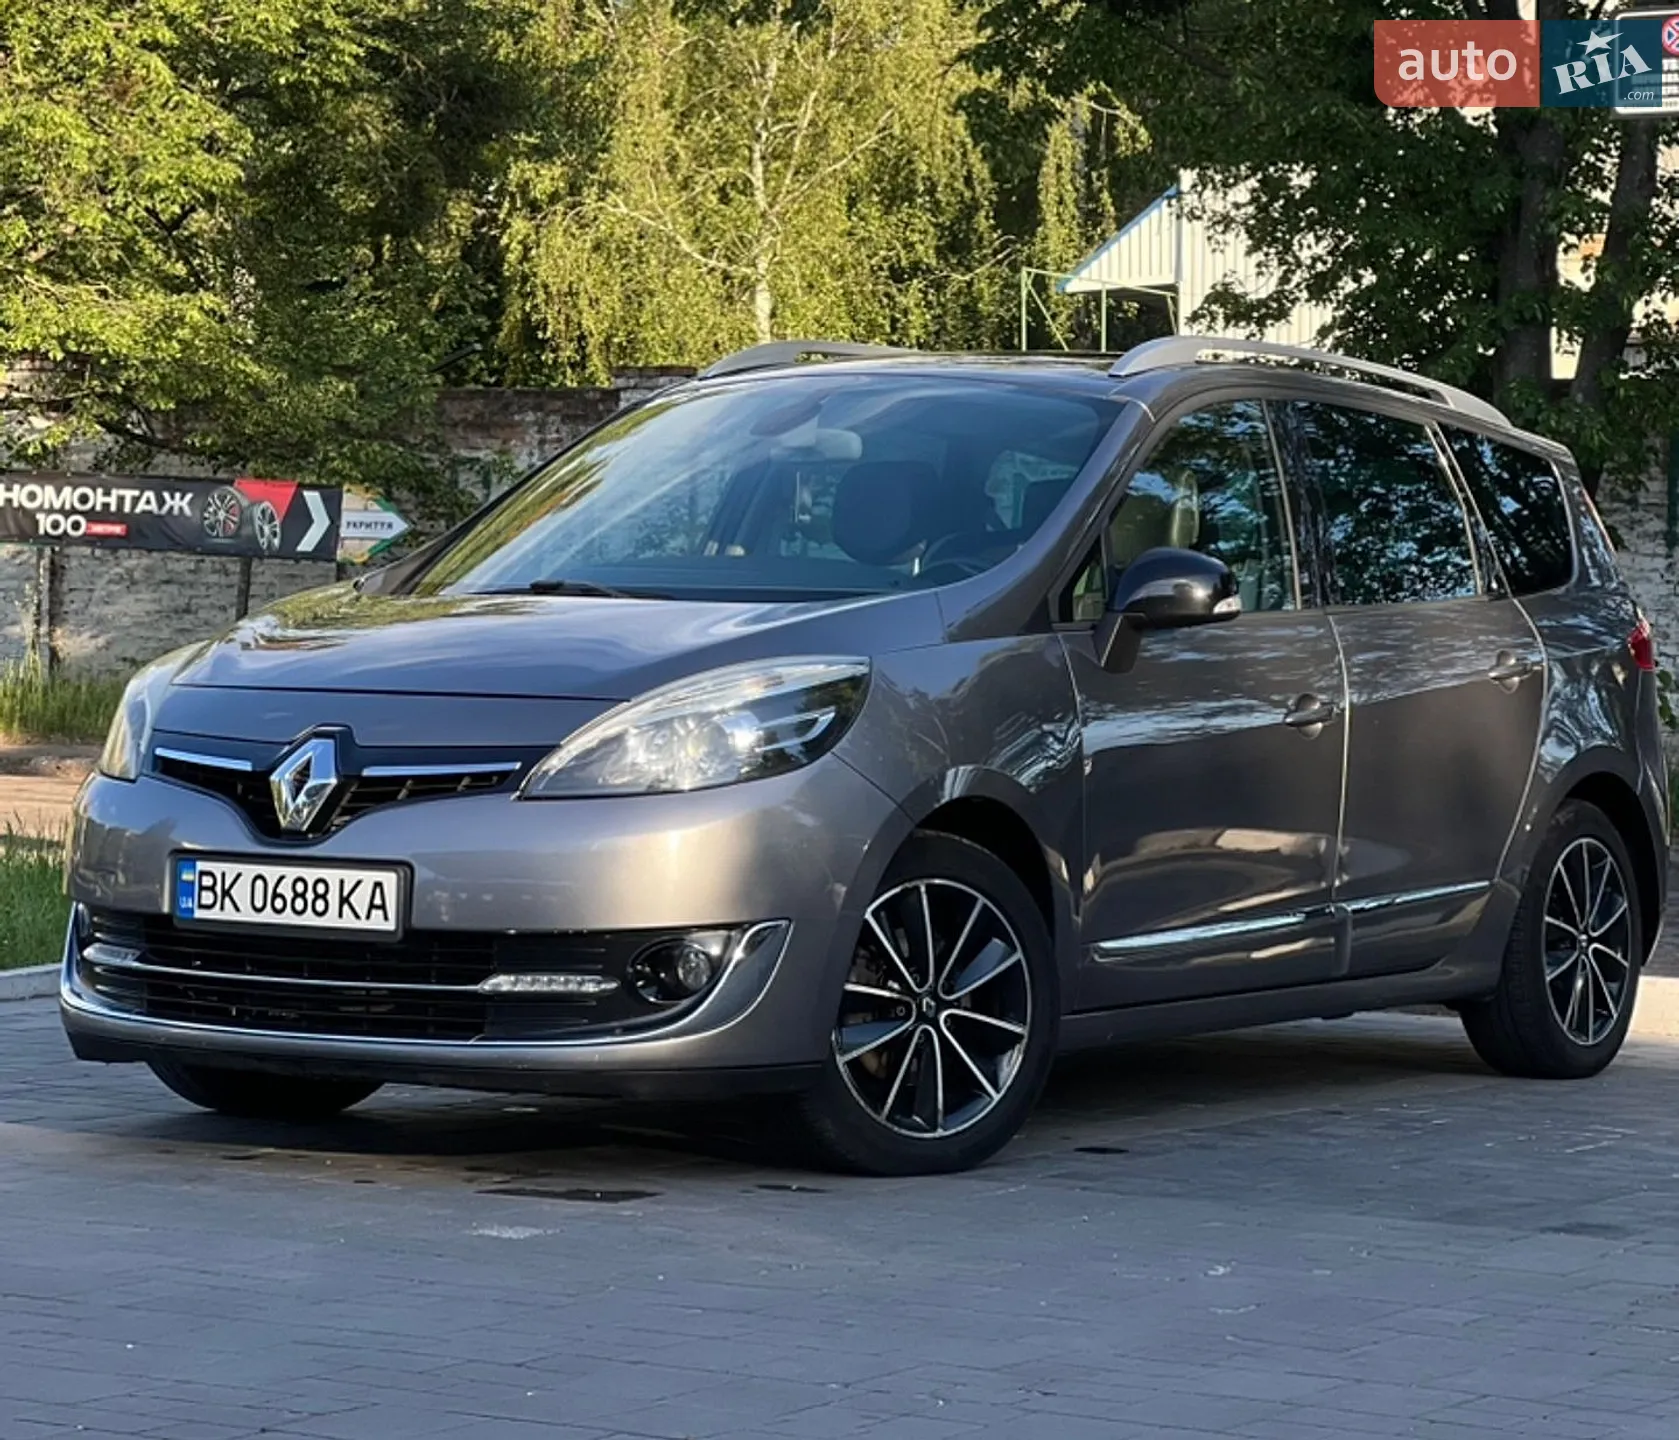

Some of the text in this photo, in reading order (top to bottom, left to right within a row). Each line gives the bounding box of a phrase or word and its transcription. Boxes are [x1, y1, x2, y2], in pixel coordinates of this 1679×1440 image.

[35, 512, 86, 537] 100
[197, 870, 390, 922] BK 0688 KA
